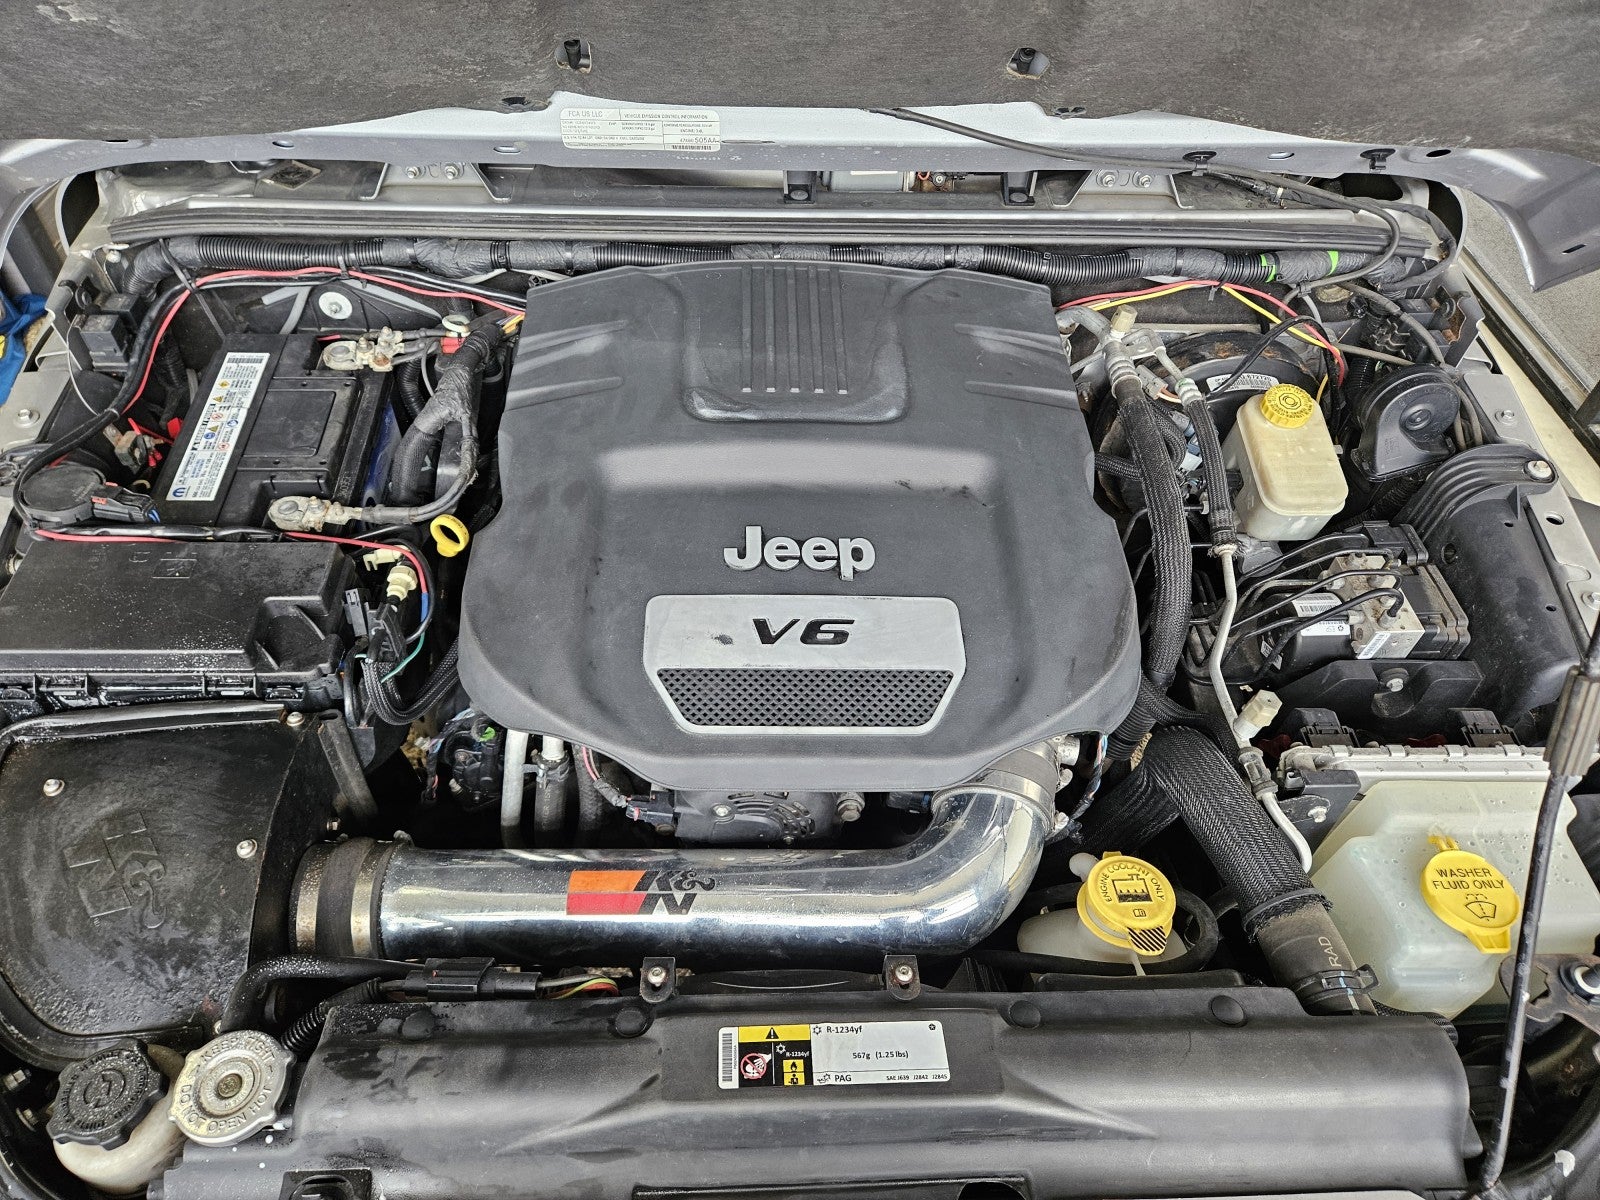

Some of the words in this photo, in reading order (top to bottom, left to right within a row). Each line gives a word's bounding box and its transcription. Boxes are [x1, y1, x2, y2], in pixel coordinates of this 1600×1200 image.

[591, 110, 603, 118] LLC
[723, 525, 876, 581] Jeep
[752, 618, 855, 645] V6
[1435, 868, 1492, 878] WASHER
[1100, 873, 1112, 903] ENGINE
[1107, 862, 1150, 877] COOLANT
[1150, 877, 1165, 901] ONLY
[1432, 880, 1470, 890] FLUID
[1472, 879, 1504, 889] ONLY
[1318, 936, 1342, 967] RAD
[826, 1025, 862, 1035] R-1234yf
[200, 1037, 240, 1062] KEEP
[244, 1036, 275, 1062] TIGHT
[852, 1052, 871, 1060] 567g
[875, 1051, 895, 1060] (1.25
[895, 1050, 909, 1059] lbs)
[834, 1074, 852, 1082] PAG
[182, 1104, 208, 1129] NOT
[207, 1112, 248, 1132] OPEN
[248, 1085, 273, 1115] HOT
